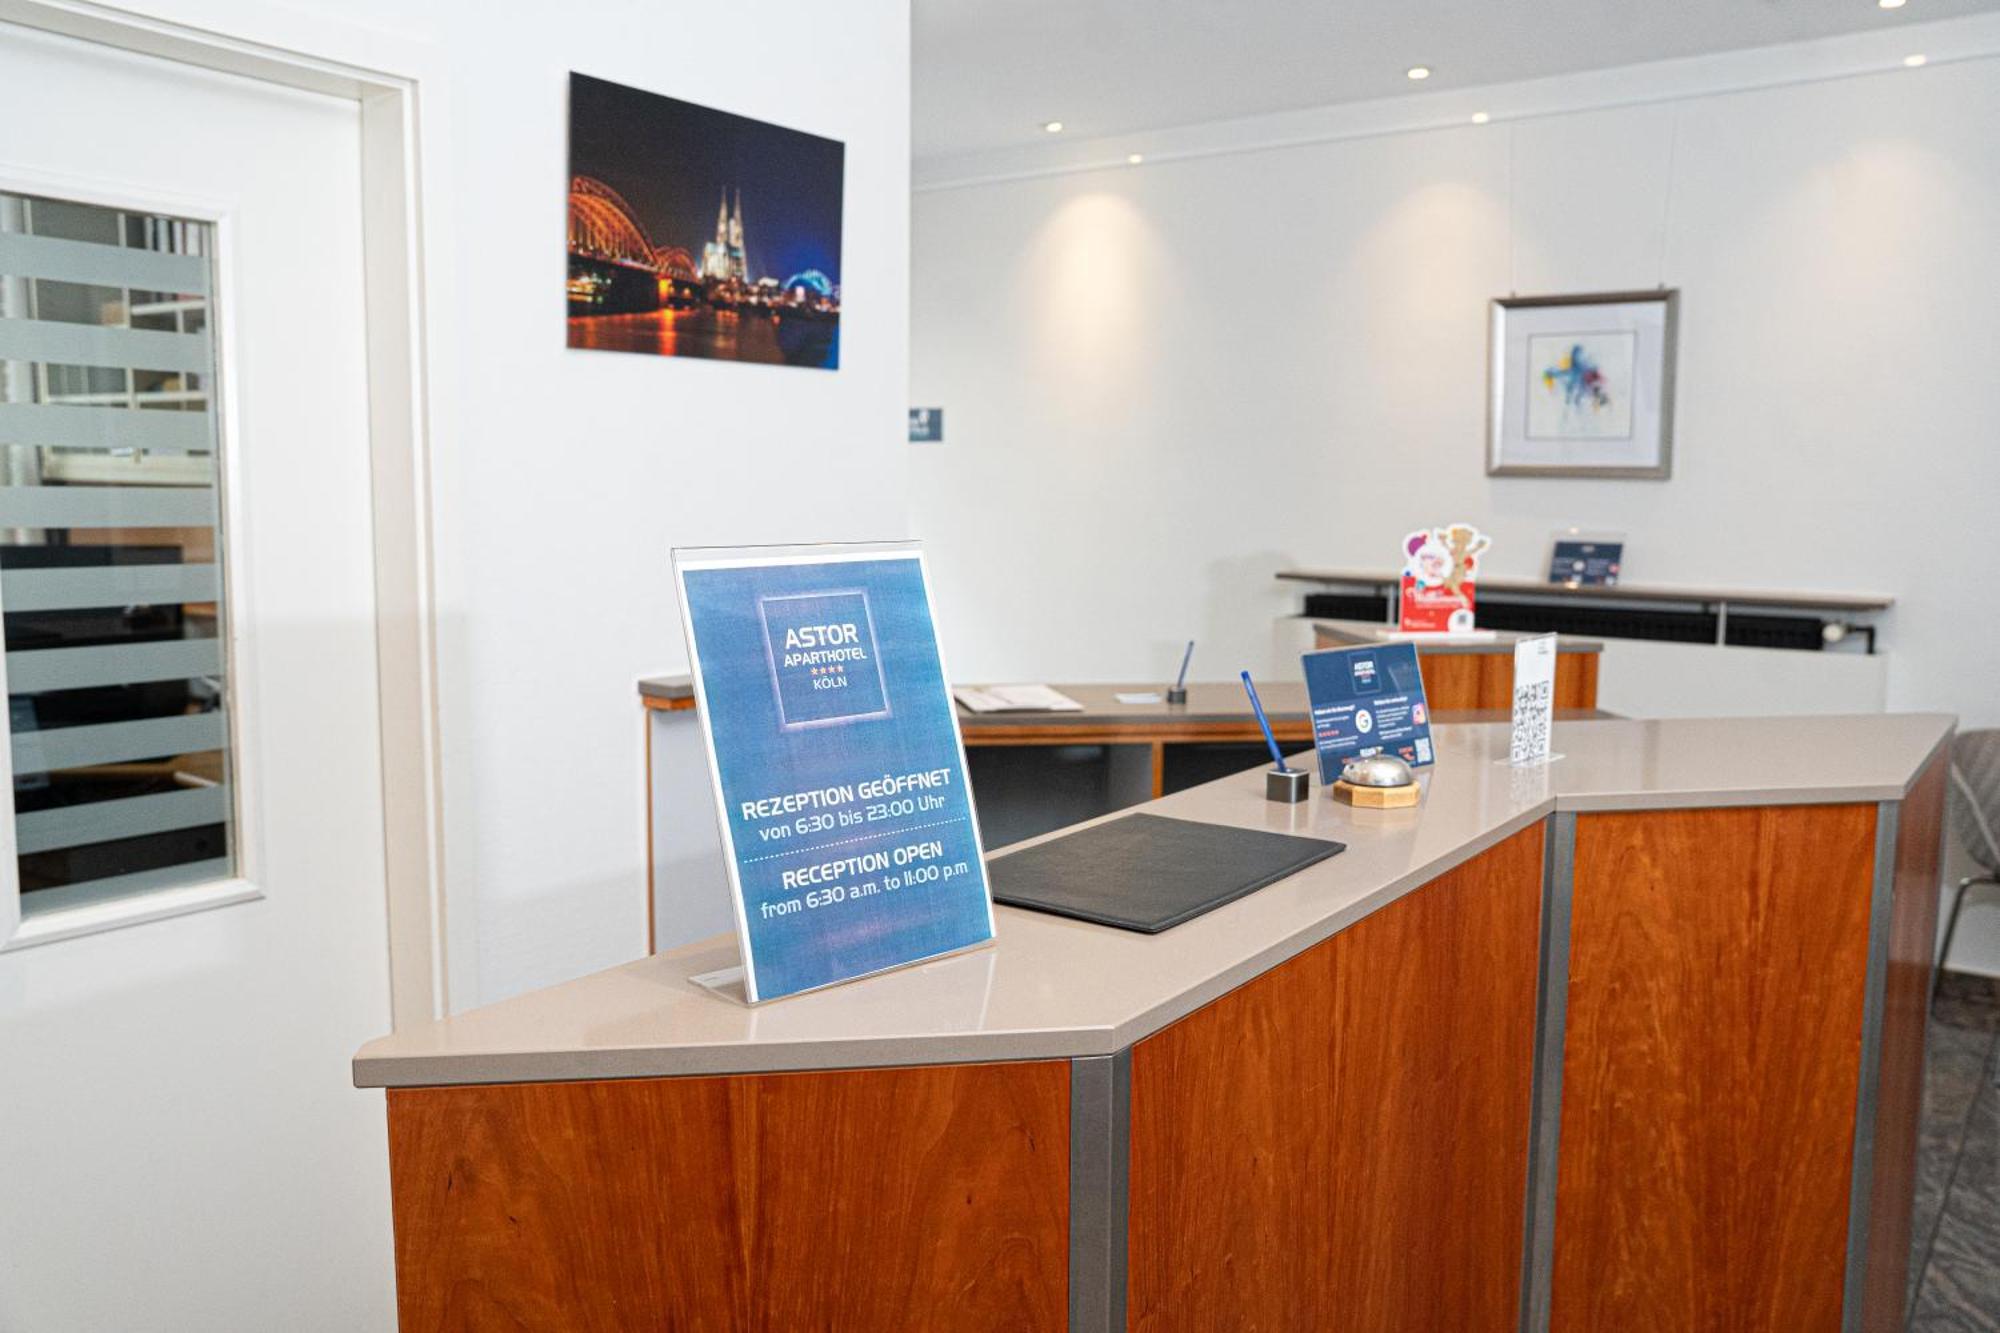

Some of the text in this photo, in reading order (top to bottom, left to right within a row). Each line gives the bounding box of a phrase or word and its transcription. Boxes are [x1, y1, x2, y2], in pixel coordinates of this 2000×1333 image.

[784, 647, 868, 668] APARTHOTEL
[785, 623, 859, 649] ASTOR
[813, 676, 848, 690] KÖLN
[741, 768, 951, 821] REZEPTION GEÖFFNET
[759, 795, 945, 841] von 6:30 bis 23:00 Uhr
[782, 841, 943, 890] RECEPTION OPEN
[761, 861, 968, 919] from 6:30 a.m. to 11:00 p.m
